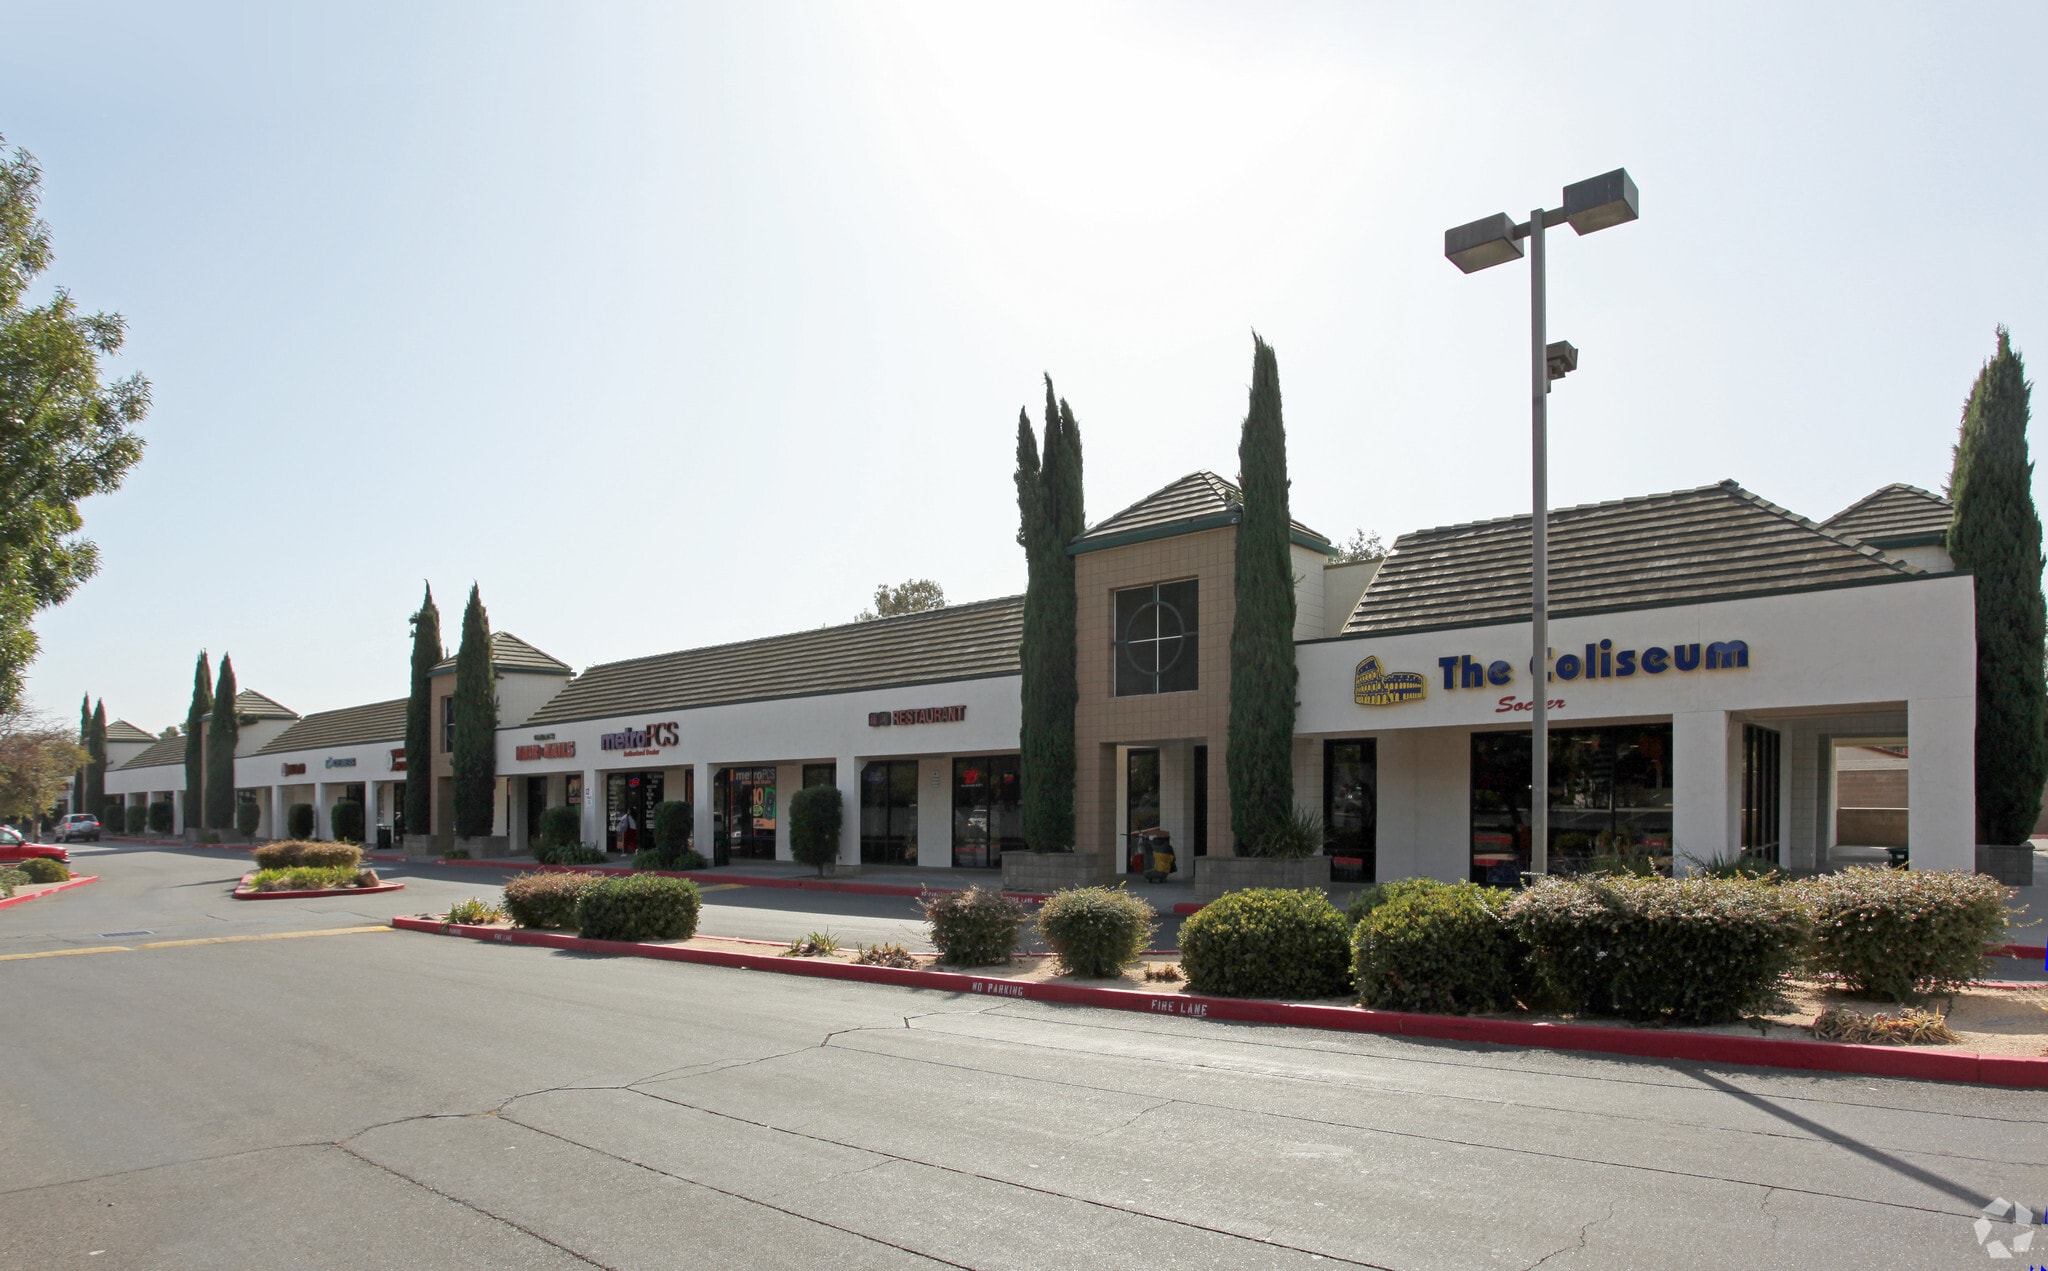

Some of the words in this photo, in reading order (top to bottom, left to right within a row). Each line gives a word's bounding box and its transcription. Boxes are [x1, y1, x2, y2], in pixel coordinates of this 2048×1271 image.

[1438, 655, 1515, 690] The
[1529, 638, 1750, 683] oliseum
[1495, 695, 1566, 713] Socer
[892, 705, 967, 725] RESTAURANT
[601, 721, 679, 750] metroPCS
[544, 740, 576, 759] NAILS
[972, 982, 983, 992] NO
[987, 983, 1024, 996] PARKING
[1151, 999, 1175, 1012] FIRE
[1180, 1002, 1208, 1016] LANE
